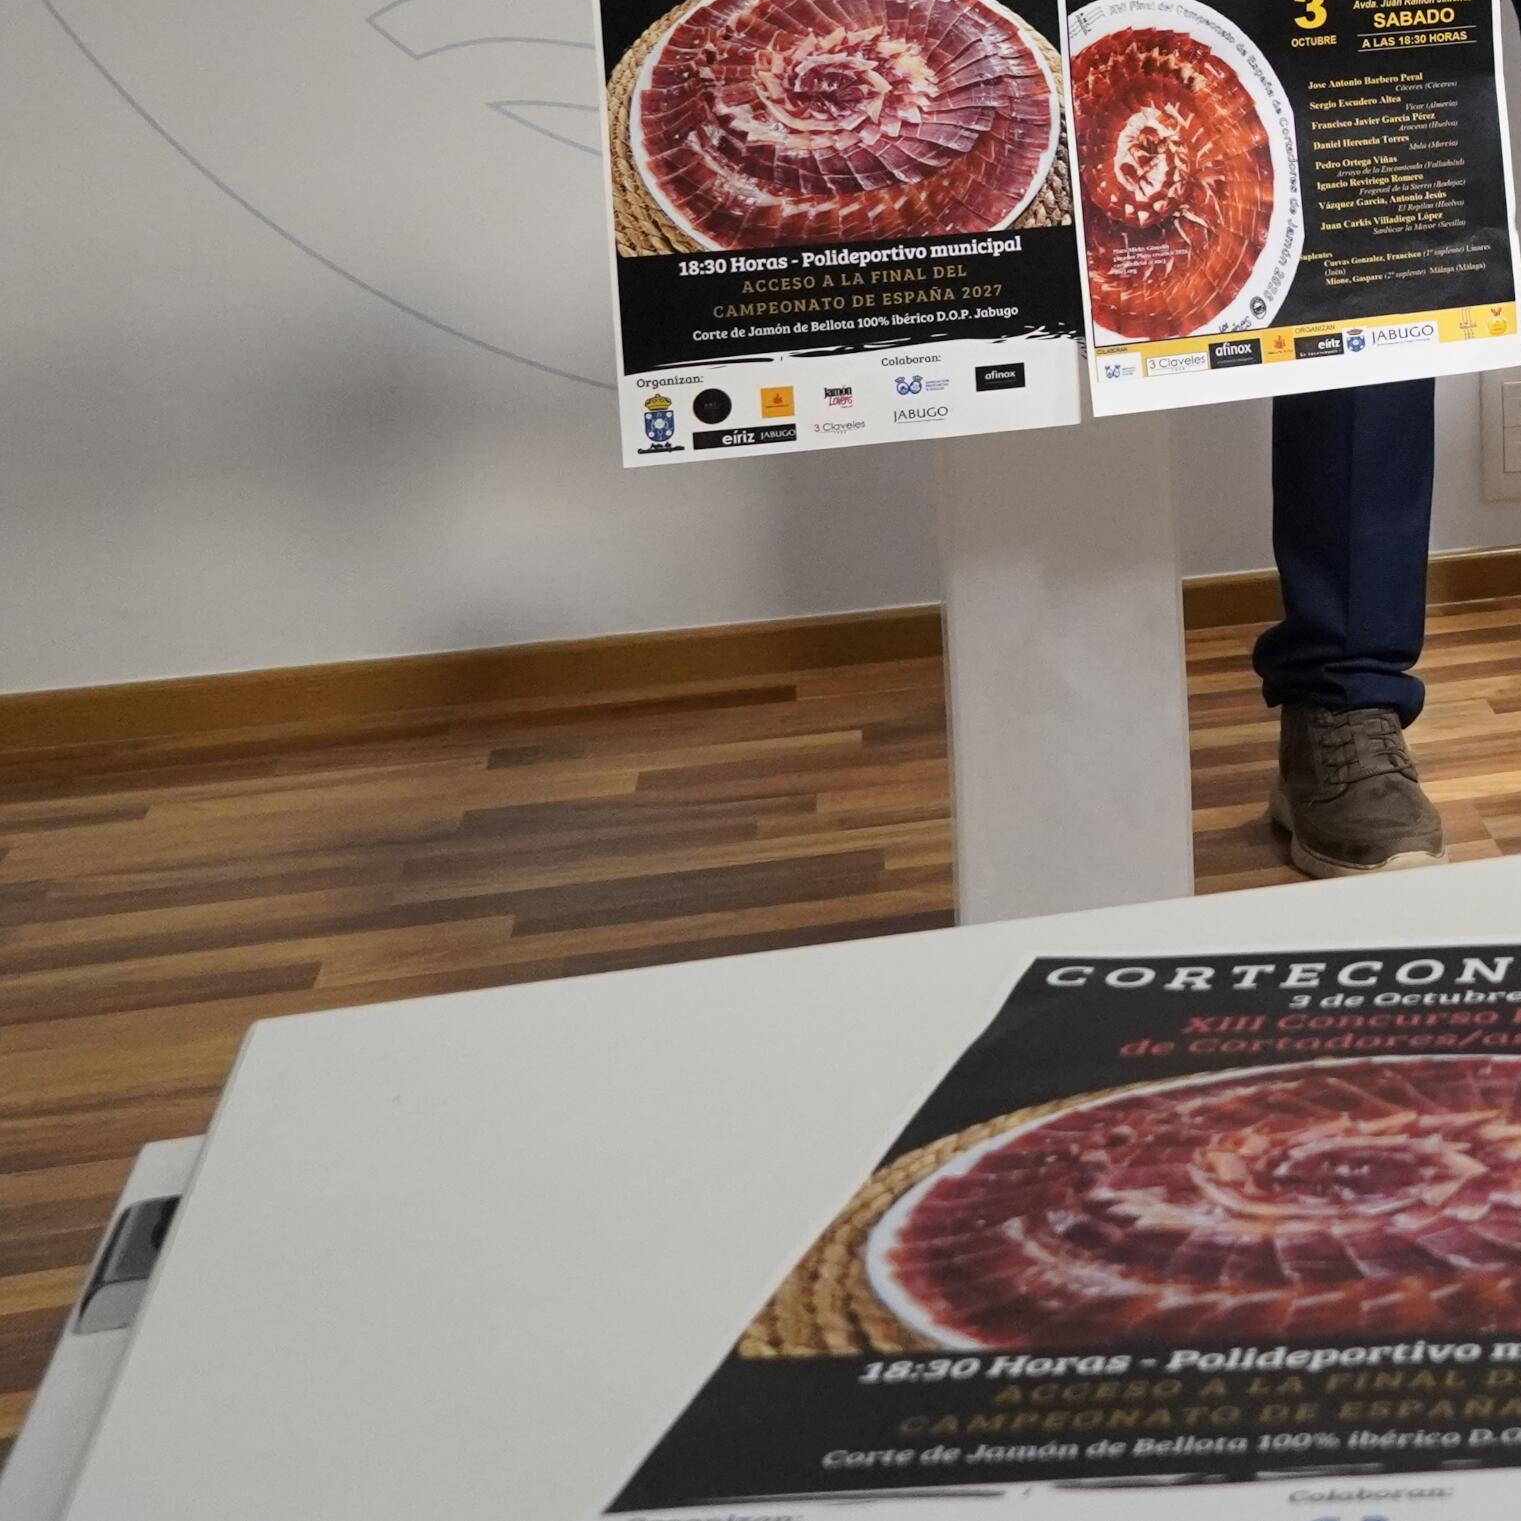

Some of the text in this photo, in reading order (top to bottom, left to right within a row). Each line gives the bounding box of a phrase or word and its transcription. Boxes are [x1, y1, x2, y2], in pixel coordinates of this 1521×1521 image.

[1353, 0, 1378, 10] Avda.
[1373, 7, 1455, 29] SABADO
[1291, 34, 1337, 48] OCTUBRE
[1361, 30, 1468, 49] A LAS 18:30 HORAS
[679, 235, 1023, 277] 18:30 Horas Polideportivo municipal
[741, 264, 967, 294] ACCESO A LA FINAL DEL
[713, 284, 1003, 319] CAMPEONATO DE ESPAÑA 2027
[692, 306, 1019, 342] Corte de Jamón de Bellota 100% ibérico D.O.P. Jabugo
[1372, 324, 1434, 345] JABUGO
[1215, 341, 1252, 357] afinox
[881, 353, 942, 367] Colaboran:
[637, 374, 704, 390] Organizan:
[985, 369, 1016, 381] afinox
[893, 406, 949, 424] JABUGO
[722, 429, 797, 446] eíriz JABUGO
[1320, 992, 1364, 1009] de
[859, 1357, 980, 1384] 18:30
[984, 1351, 1132, 1379] Horas
[1164, 1339, 1483, 1373] Polideportivo
